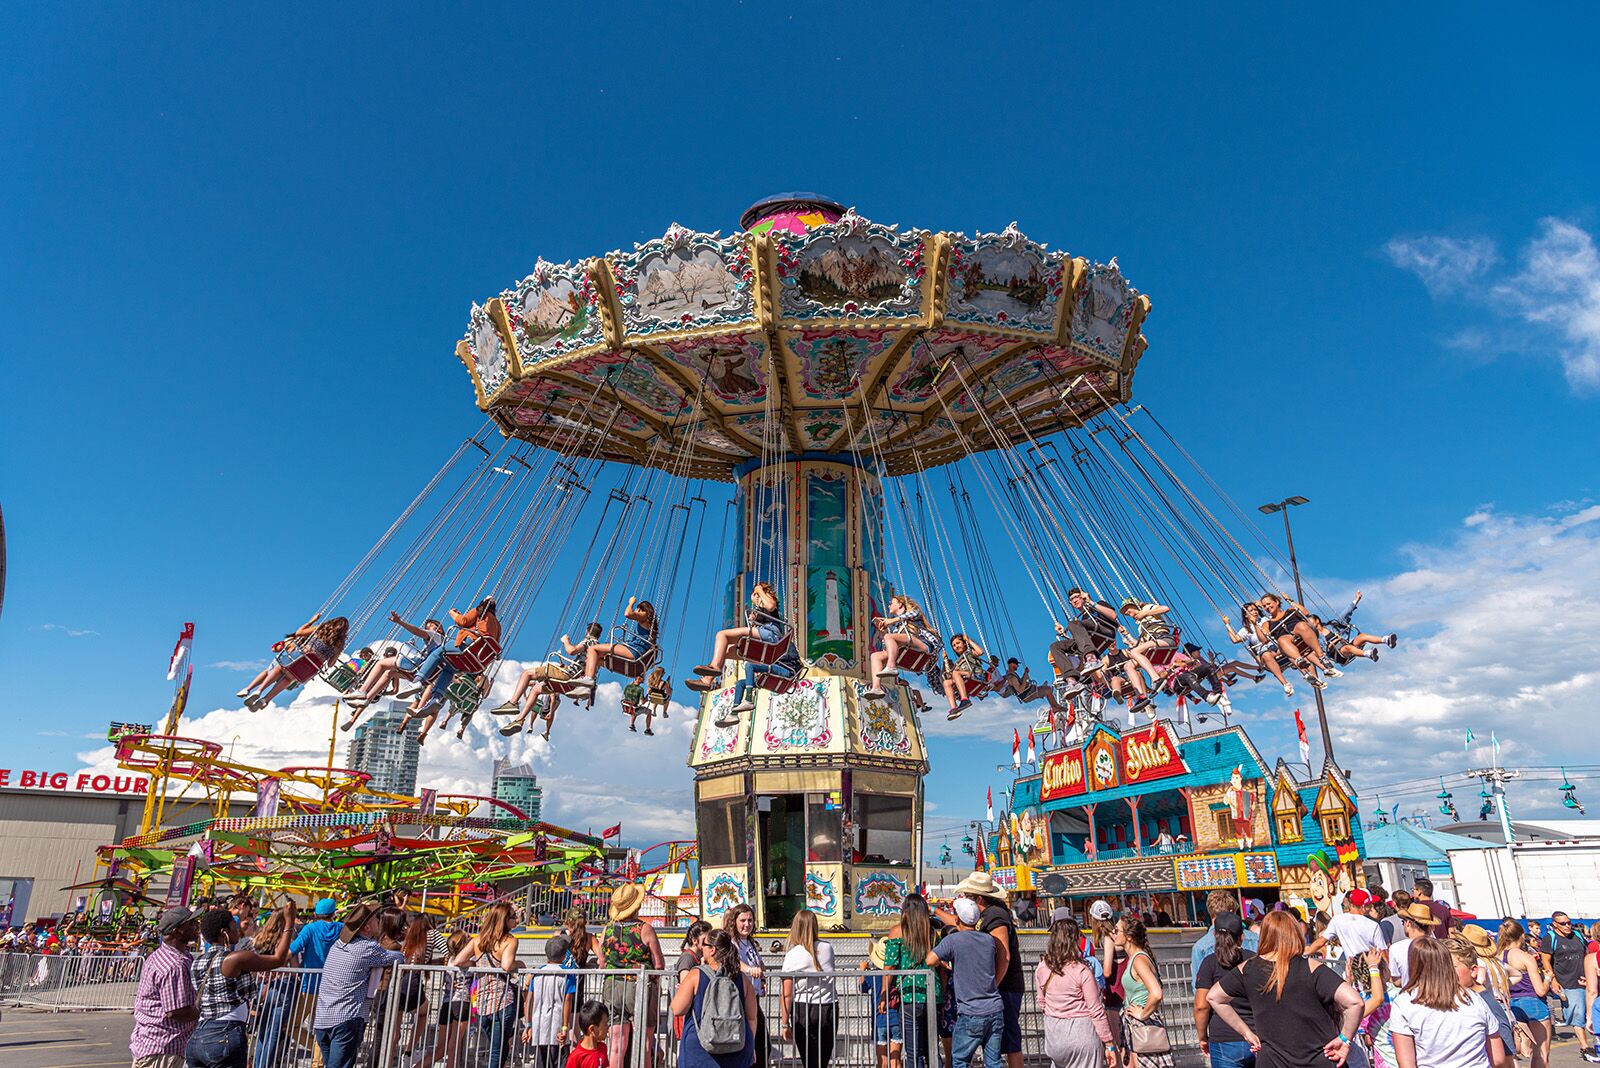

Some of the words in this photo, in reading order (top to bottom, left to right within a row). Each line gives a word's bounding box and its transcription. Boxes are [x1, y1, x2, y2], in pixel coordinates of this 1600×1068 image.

[1042, 755, 1082, 798] Cuckoo
[1126, 736, 1171, 780] Haus
[20, 770, 69, 789] BIG
[76, 774, 149, 794] FOUR
